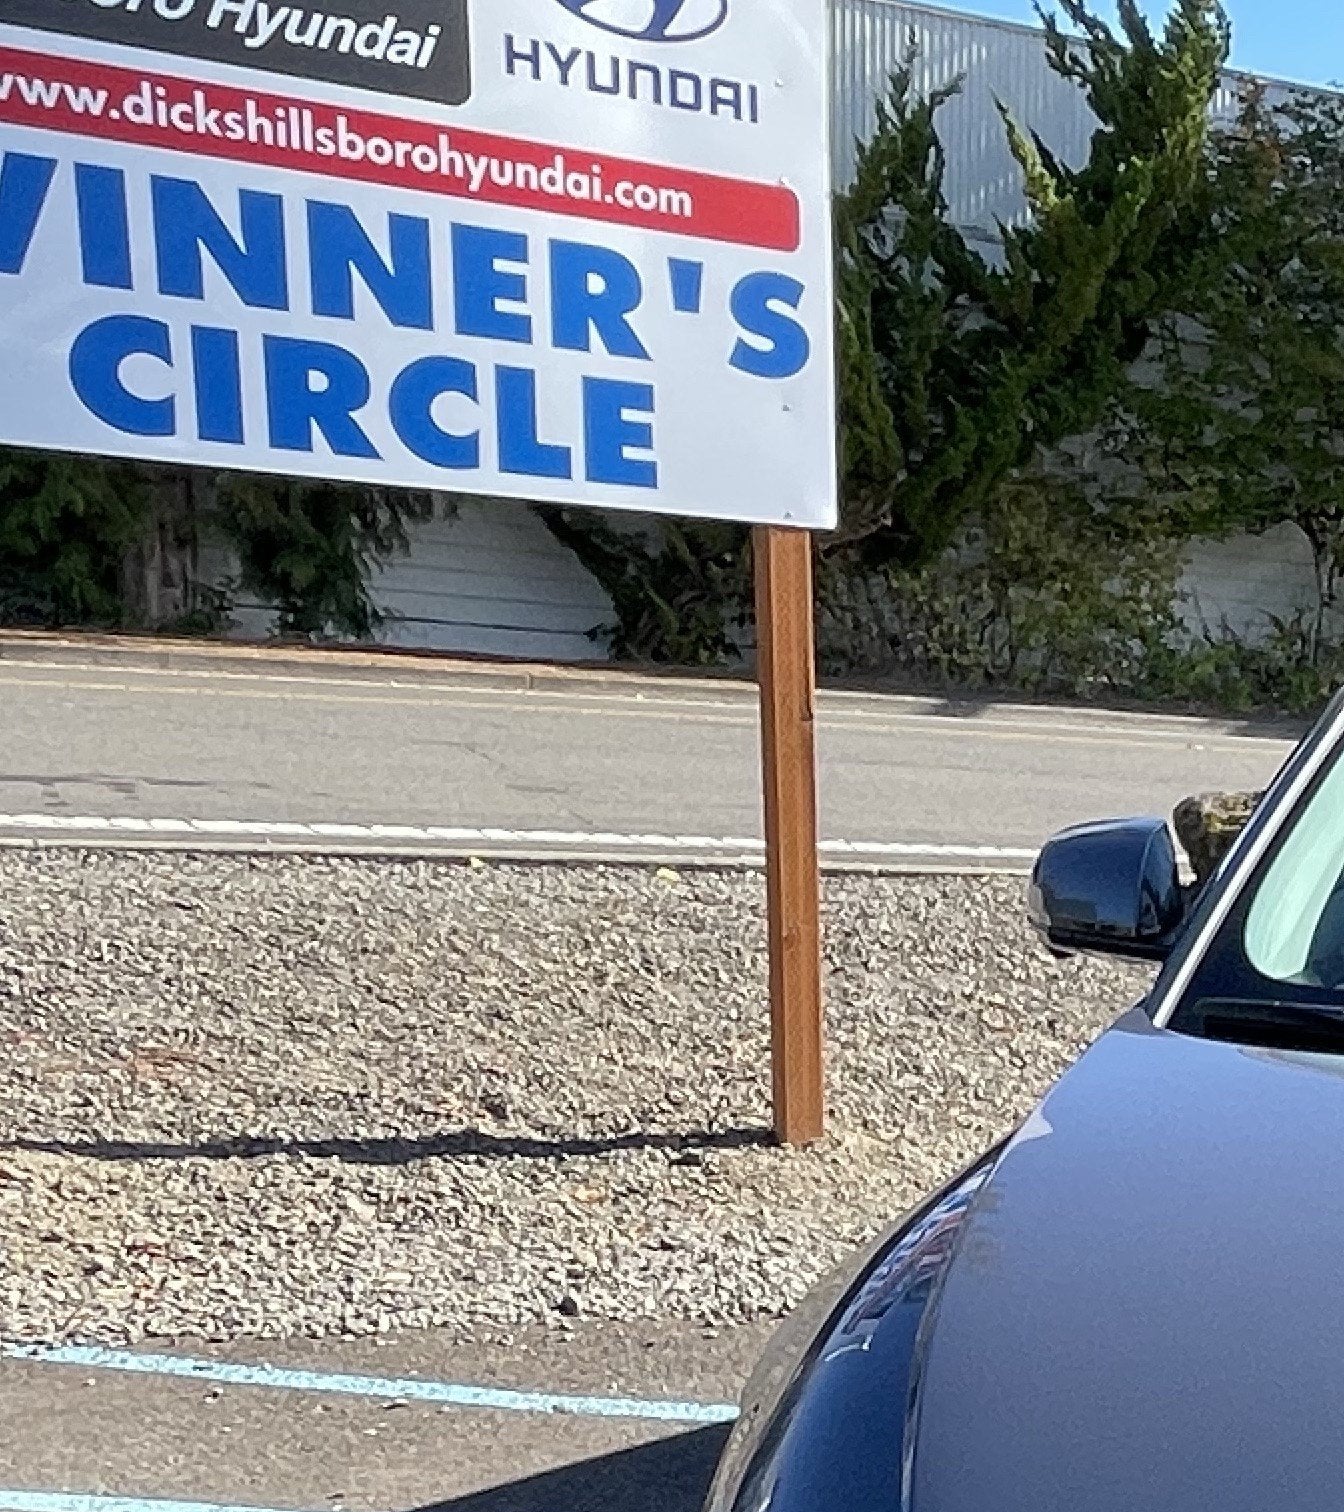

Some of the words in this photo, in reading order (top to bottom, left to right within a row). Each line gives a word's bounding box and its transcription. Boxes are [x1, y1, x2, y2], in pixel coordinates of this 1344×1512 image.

[206, 0, 441, 69] Hyundai
[503, 34, 760, 124] HYUNDAI
[68, 313, 660, 489] CIRCLE
